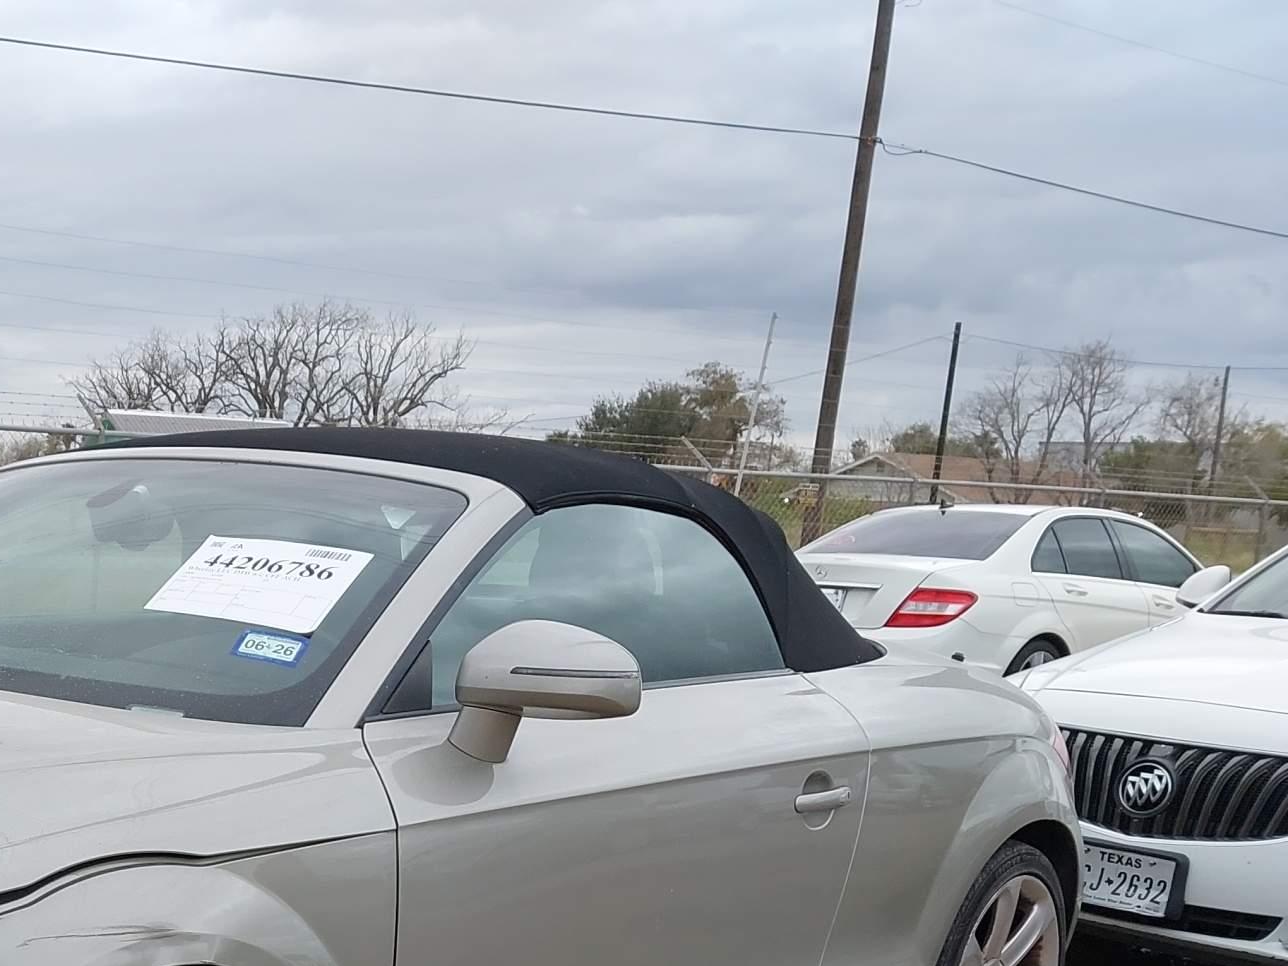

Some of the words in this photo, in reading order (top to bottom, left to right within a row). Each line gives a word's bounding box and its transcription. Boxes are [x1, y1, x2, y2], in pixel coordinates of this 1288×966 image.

[203, 553, 339, 581] 44206786
[244, 638, 267, 651] 06
[271, 643, 296, 657] 26
[1099, 850, 1143, 869] TEXAS
